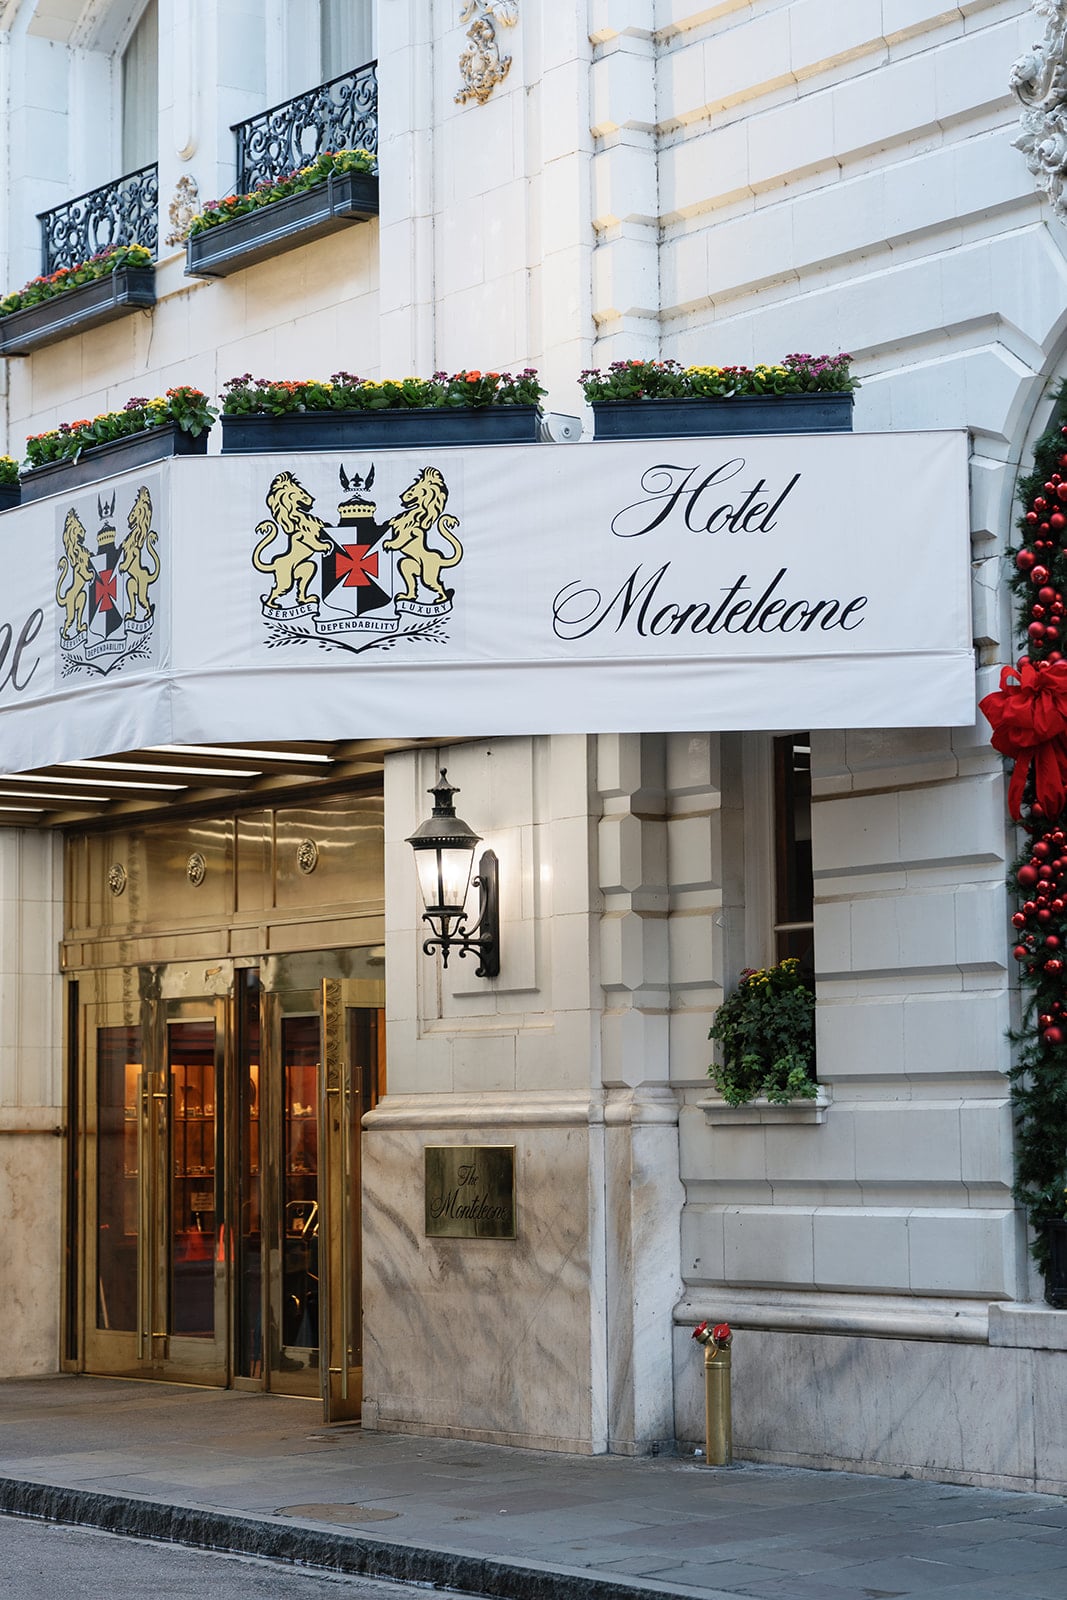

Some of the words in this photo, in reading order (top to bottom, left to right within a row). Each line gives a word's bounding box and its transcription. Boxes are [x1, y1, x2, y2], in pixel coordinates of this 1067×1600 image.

[611, 458, 801, 537] Hotel
[552, 561, 868, 640] Monteleone
[267, 604, 314, 618] SERVICE
[401, 603, 448, 615] LUXURY
[320, 621, 396, 632] DEPENDABILITY
[87, 642, 125, 657] DEPENDABILITY
